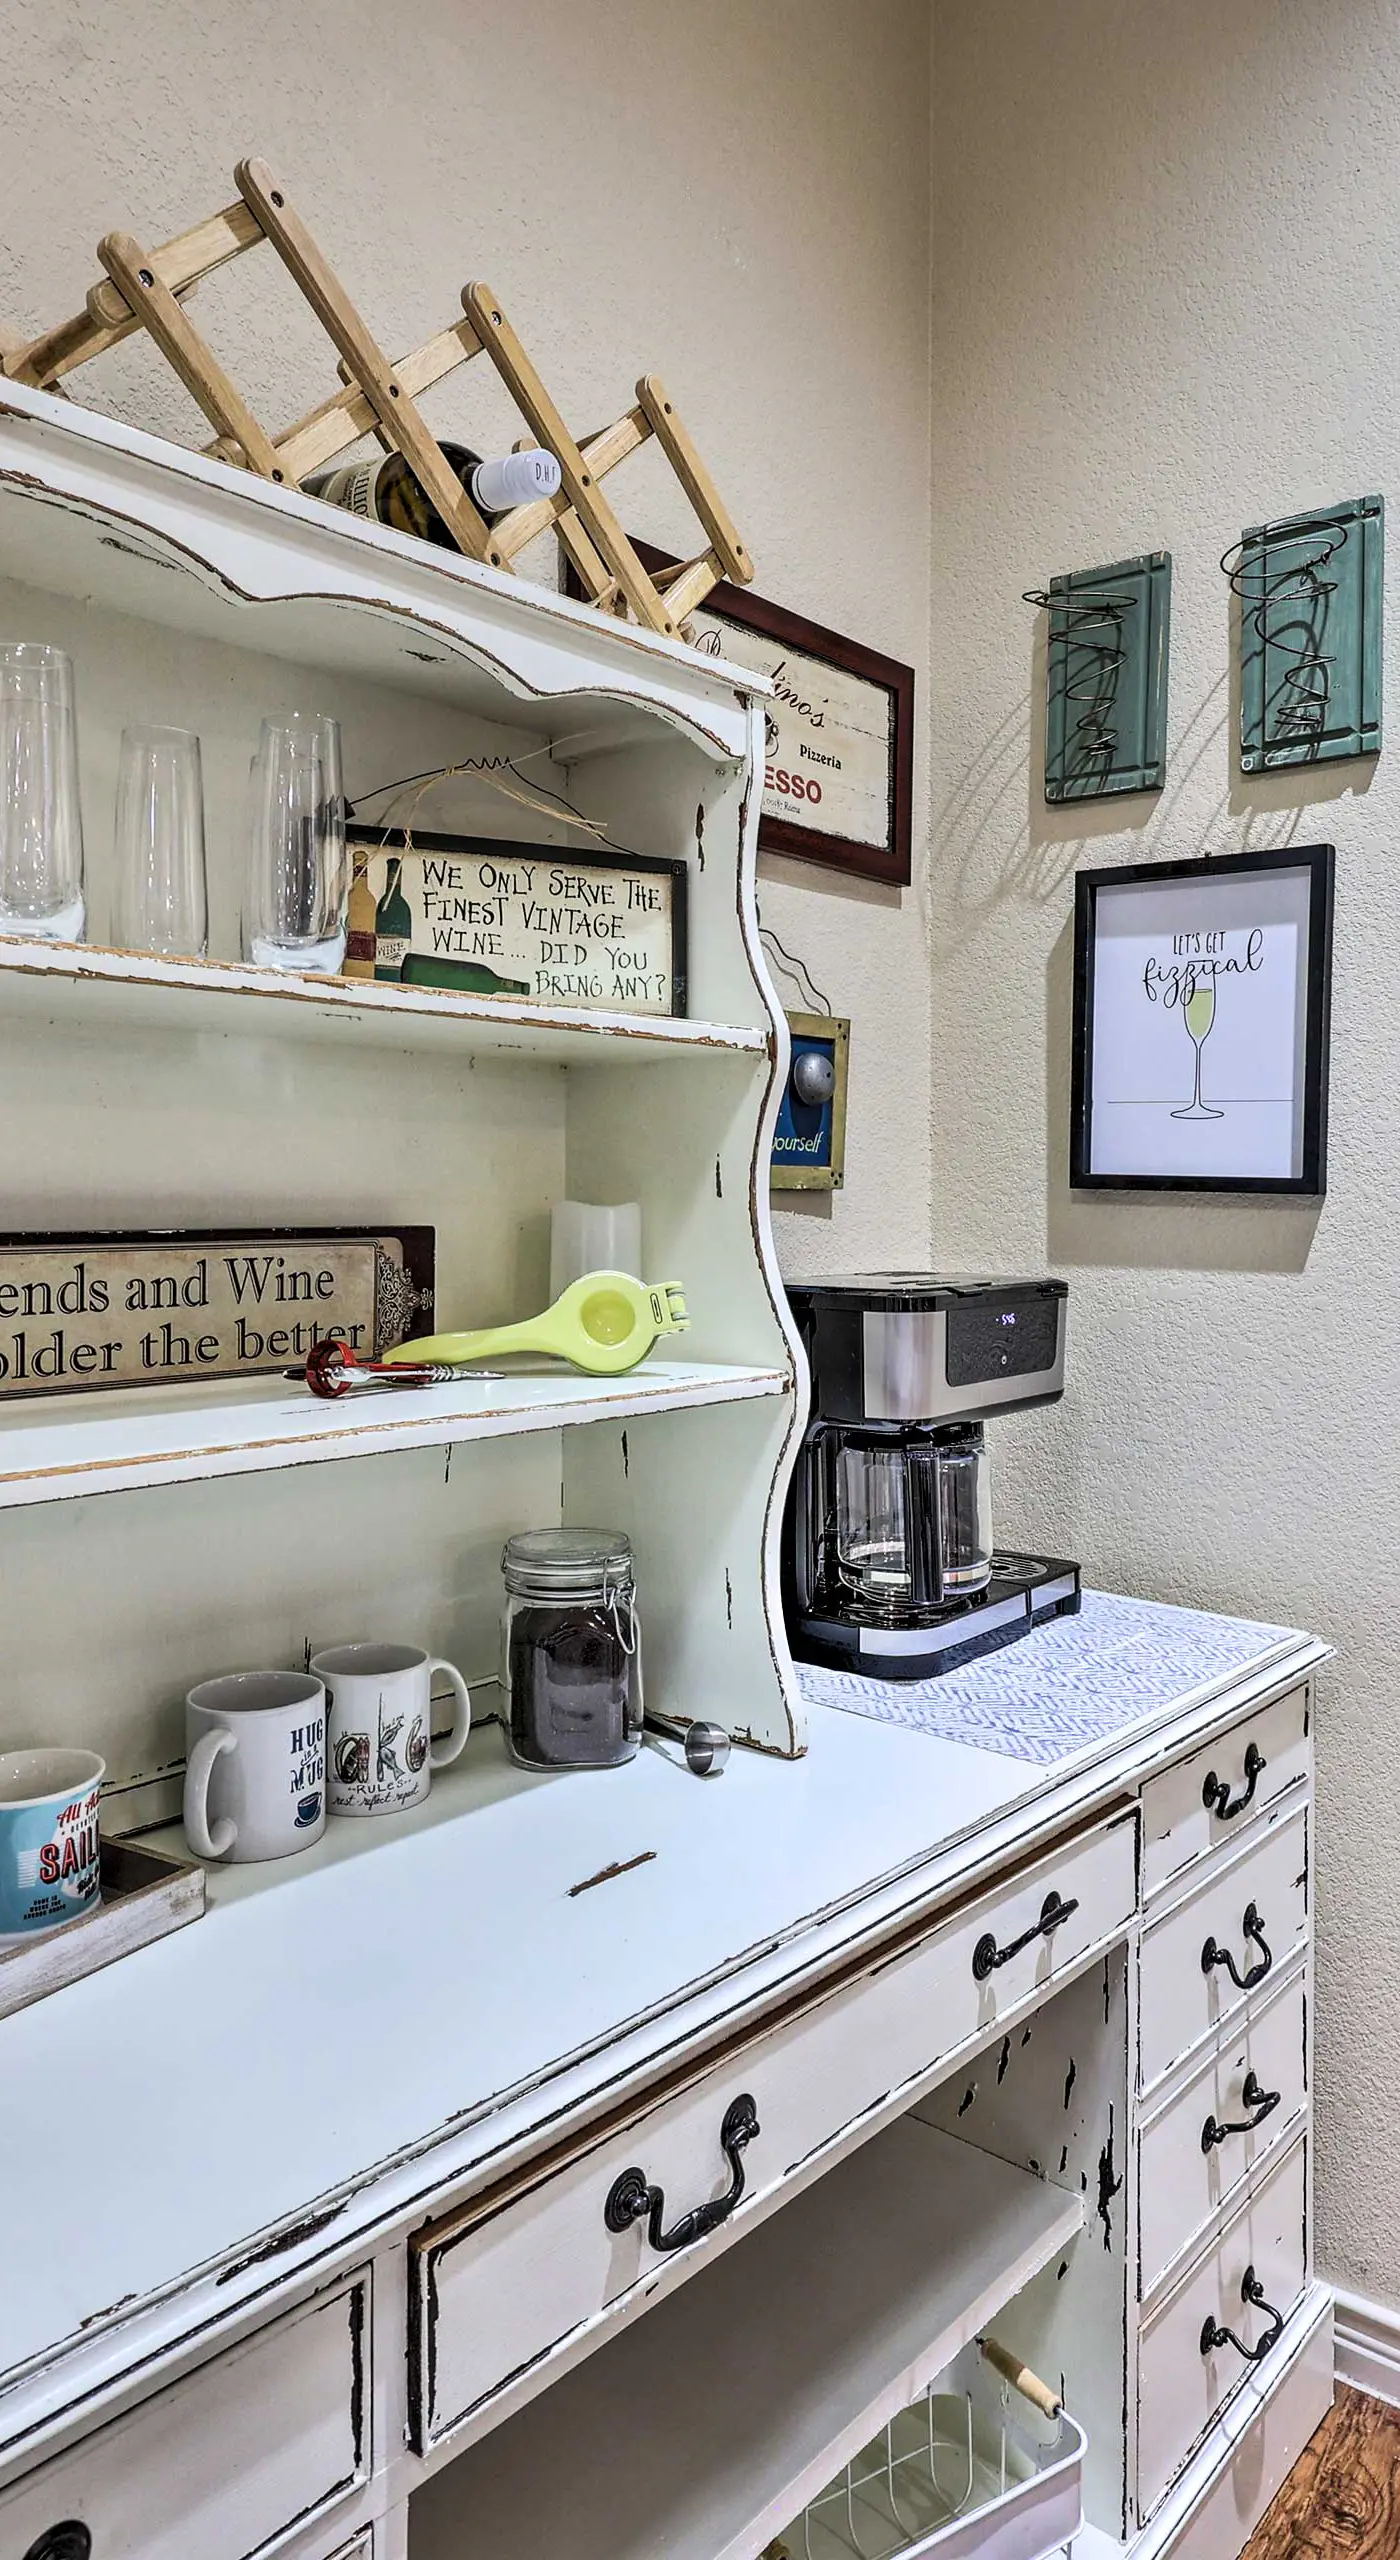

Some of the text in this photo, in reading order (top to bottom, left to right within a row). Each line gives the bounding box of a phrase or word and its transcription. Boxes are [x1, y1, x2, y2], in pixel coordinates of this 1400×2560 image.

[799, 743, 842, 771] Pizzeria
[422, 858, 662, 912] WE ONLY SERVE THE
[422, 891, 626, 939] FINEST VINTAGE
[540, 940, 588, 965] DID
[604, 947, 648, 970] YOU
[1173, 930, 1227, 955] LET'S GET
[535, 970, 667, 1001] BRING ANY?
[1142, 928, 1264, 1009] fizzical
[0, 1255, 335, 1318] ends and Wine
[140, 1321, 220, 1369] the
[234, 1316, 366, 1361] better
[290, 1718, 323, 1754] HUG
[290, 1756, 323, 1793] MUG
